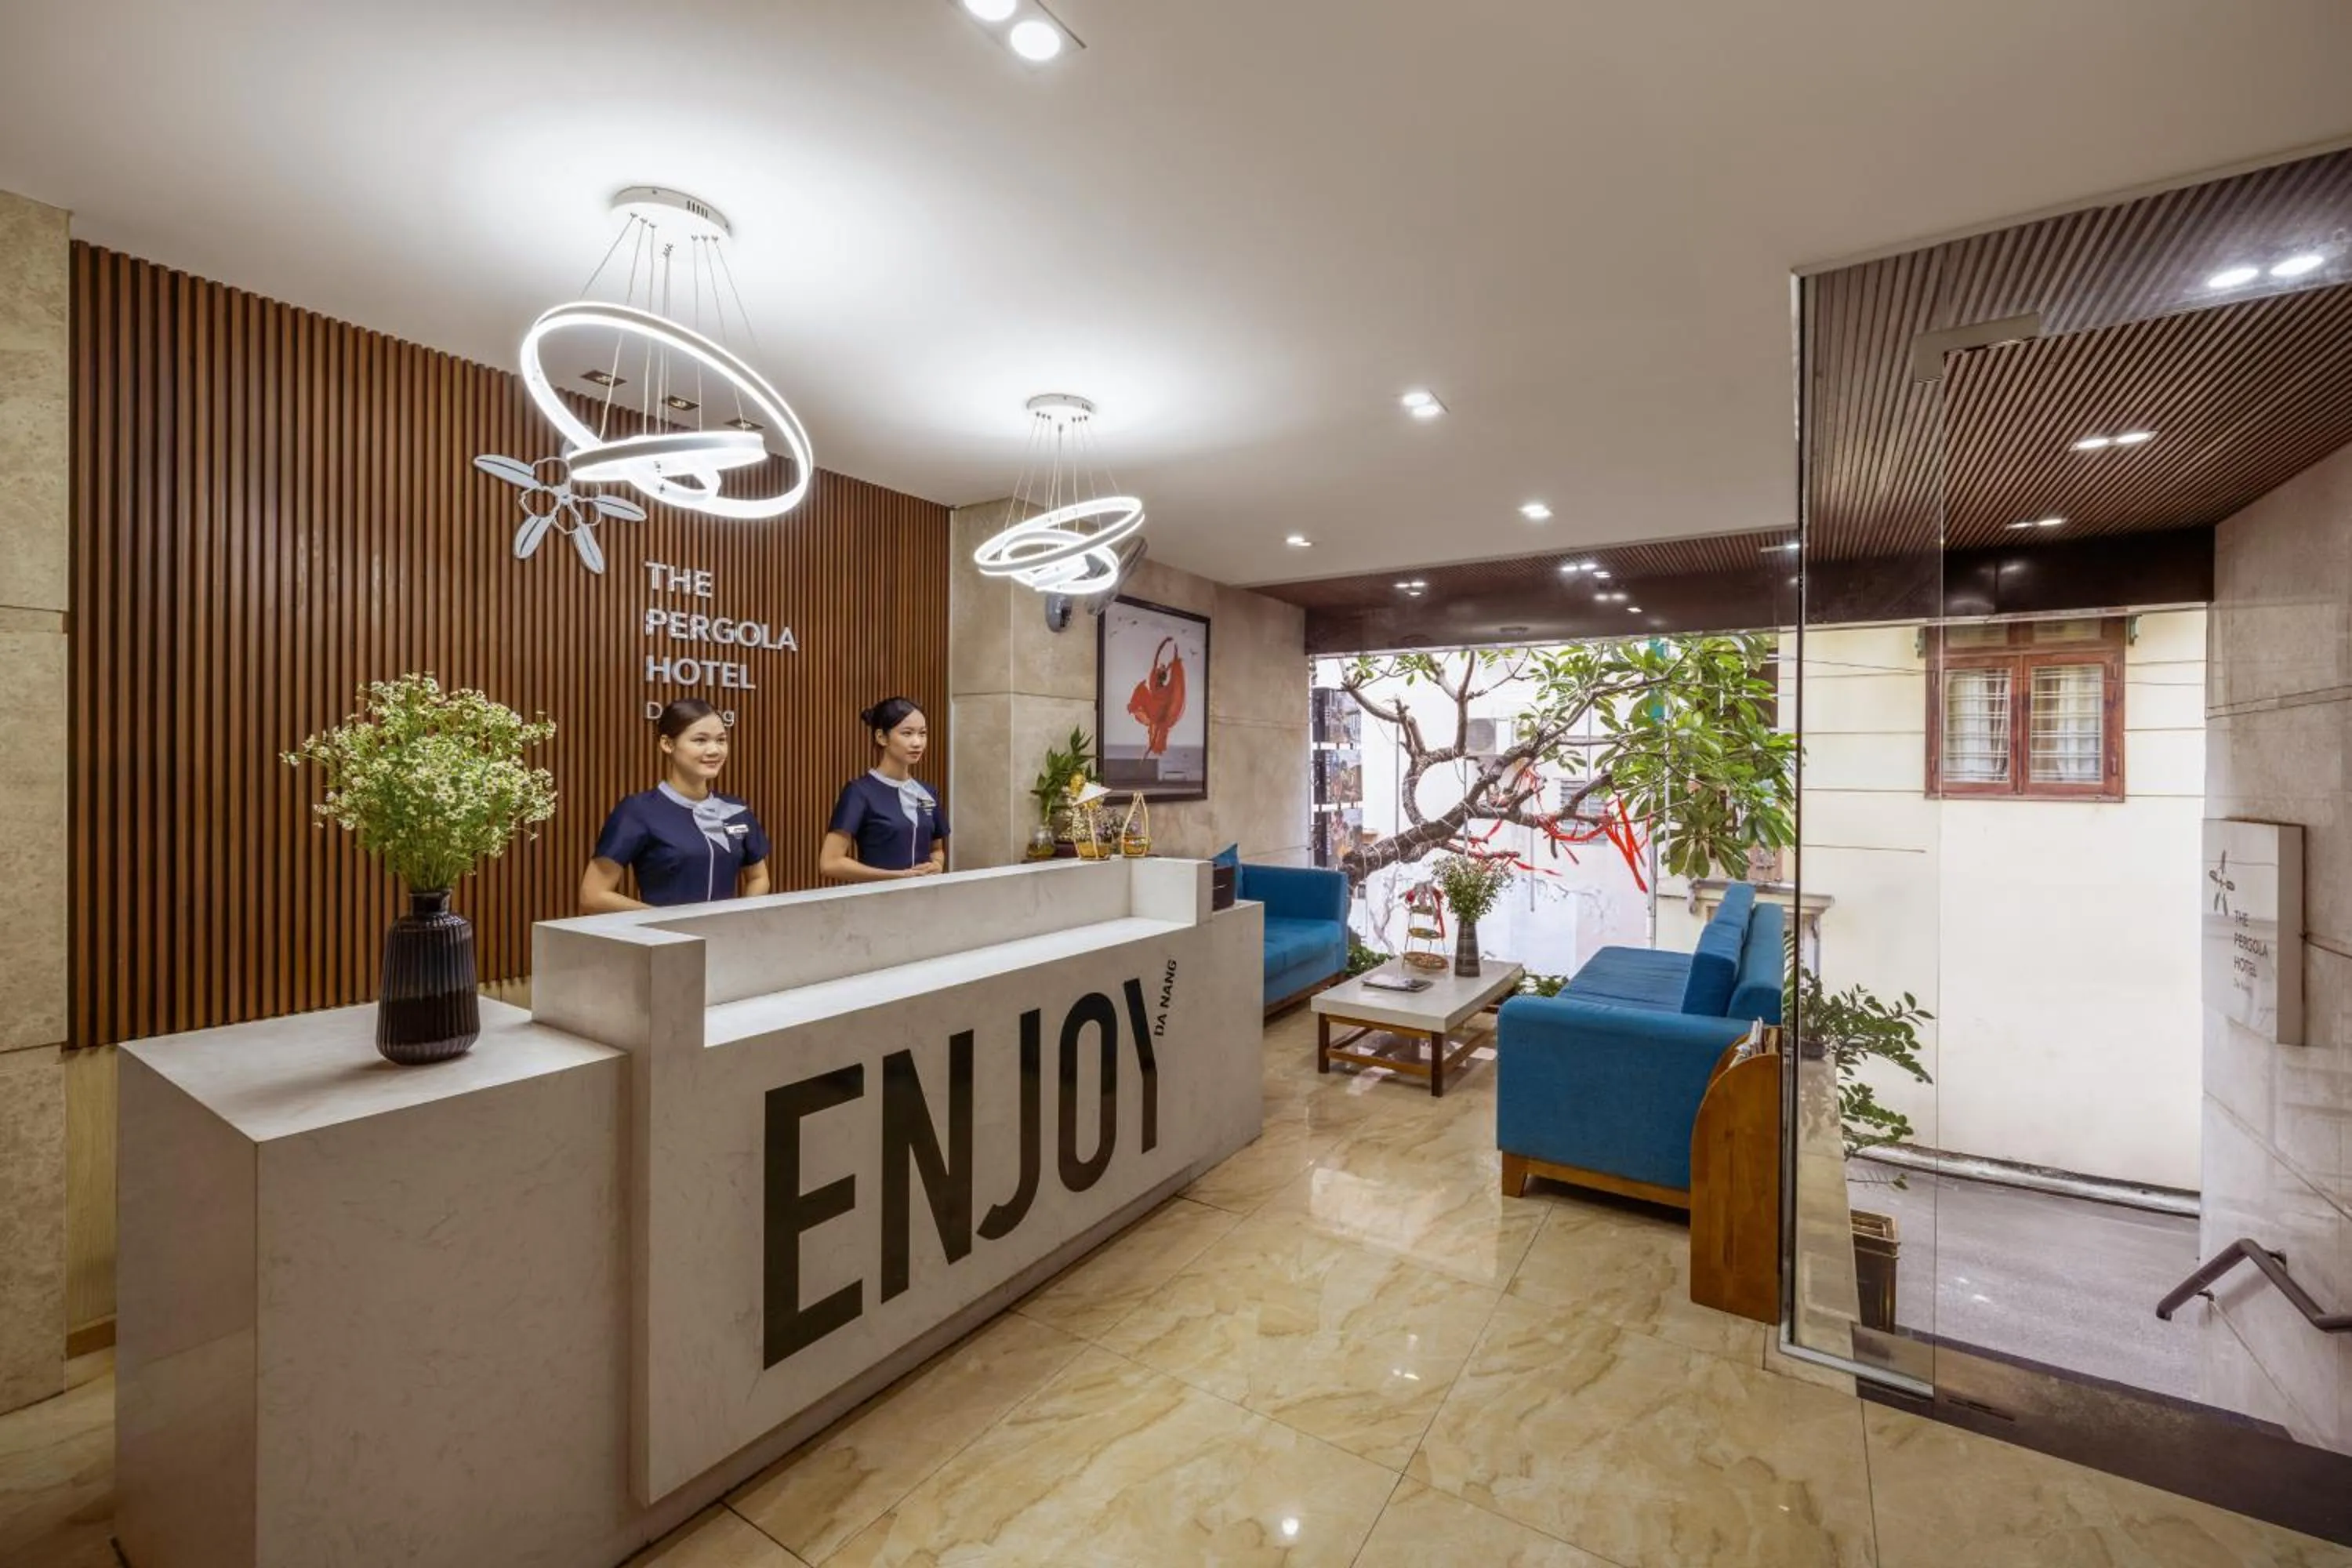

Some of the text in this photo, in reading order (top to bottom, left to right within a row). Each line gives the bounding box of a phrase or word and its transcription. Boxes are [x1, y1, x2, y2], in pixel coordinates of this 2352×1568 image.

[644, 561, 712, 597] THE
[646, 608, 798, 652] PERGOLA
[646, 655, 756, 690] HOTEL
[2234, 909, 2249, 927] THE
[1153, 959, 1177, 1036] DA NANG
[763, 978, 1158, 1371] ENJOY
